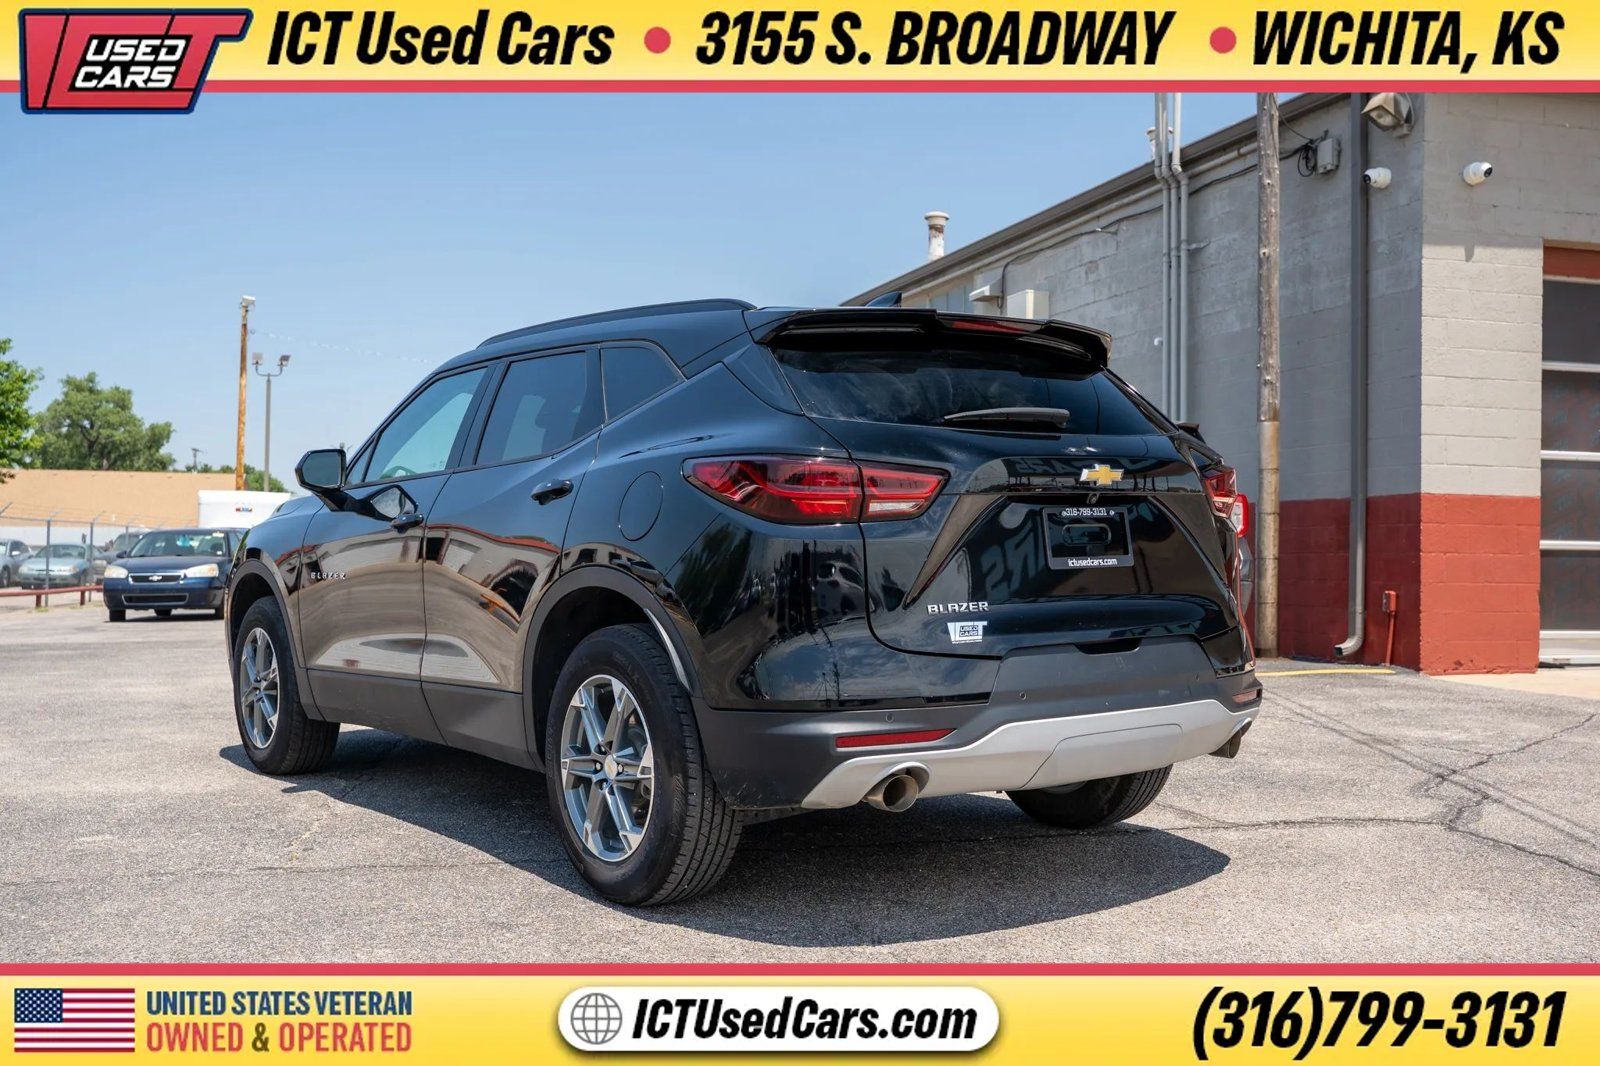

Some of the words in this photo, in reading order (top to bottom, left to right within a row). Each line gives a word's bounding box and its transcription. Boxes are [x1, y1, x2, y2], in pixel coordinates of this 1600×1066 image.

[1067, 557, 1118, 567] ictusedcars.com
[311, 572, 346, 580] BLAZER
[927, 601, 989, 615] BLAZER
